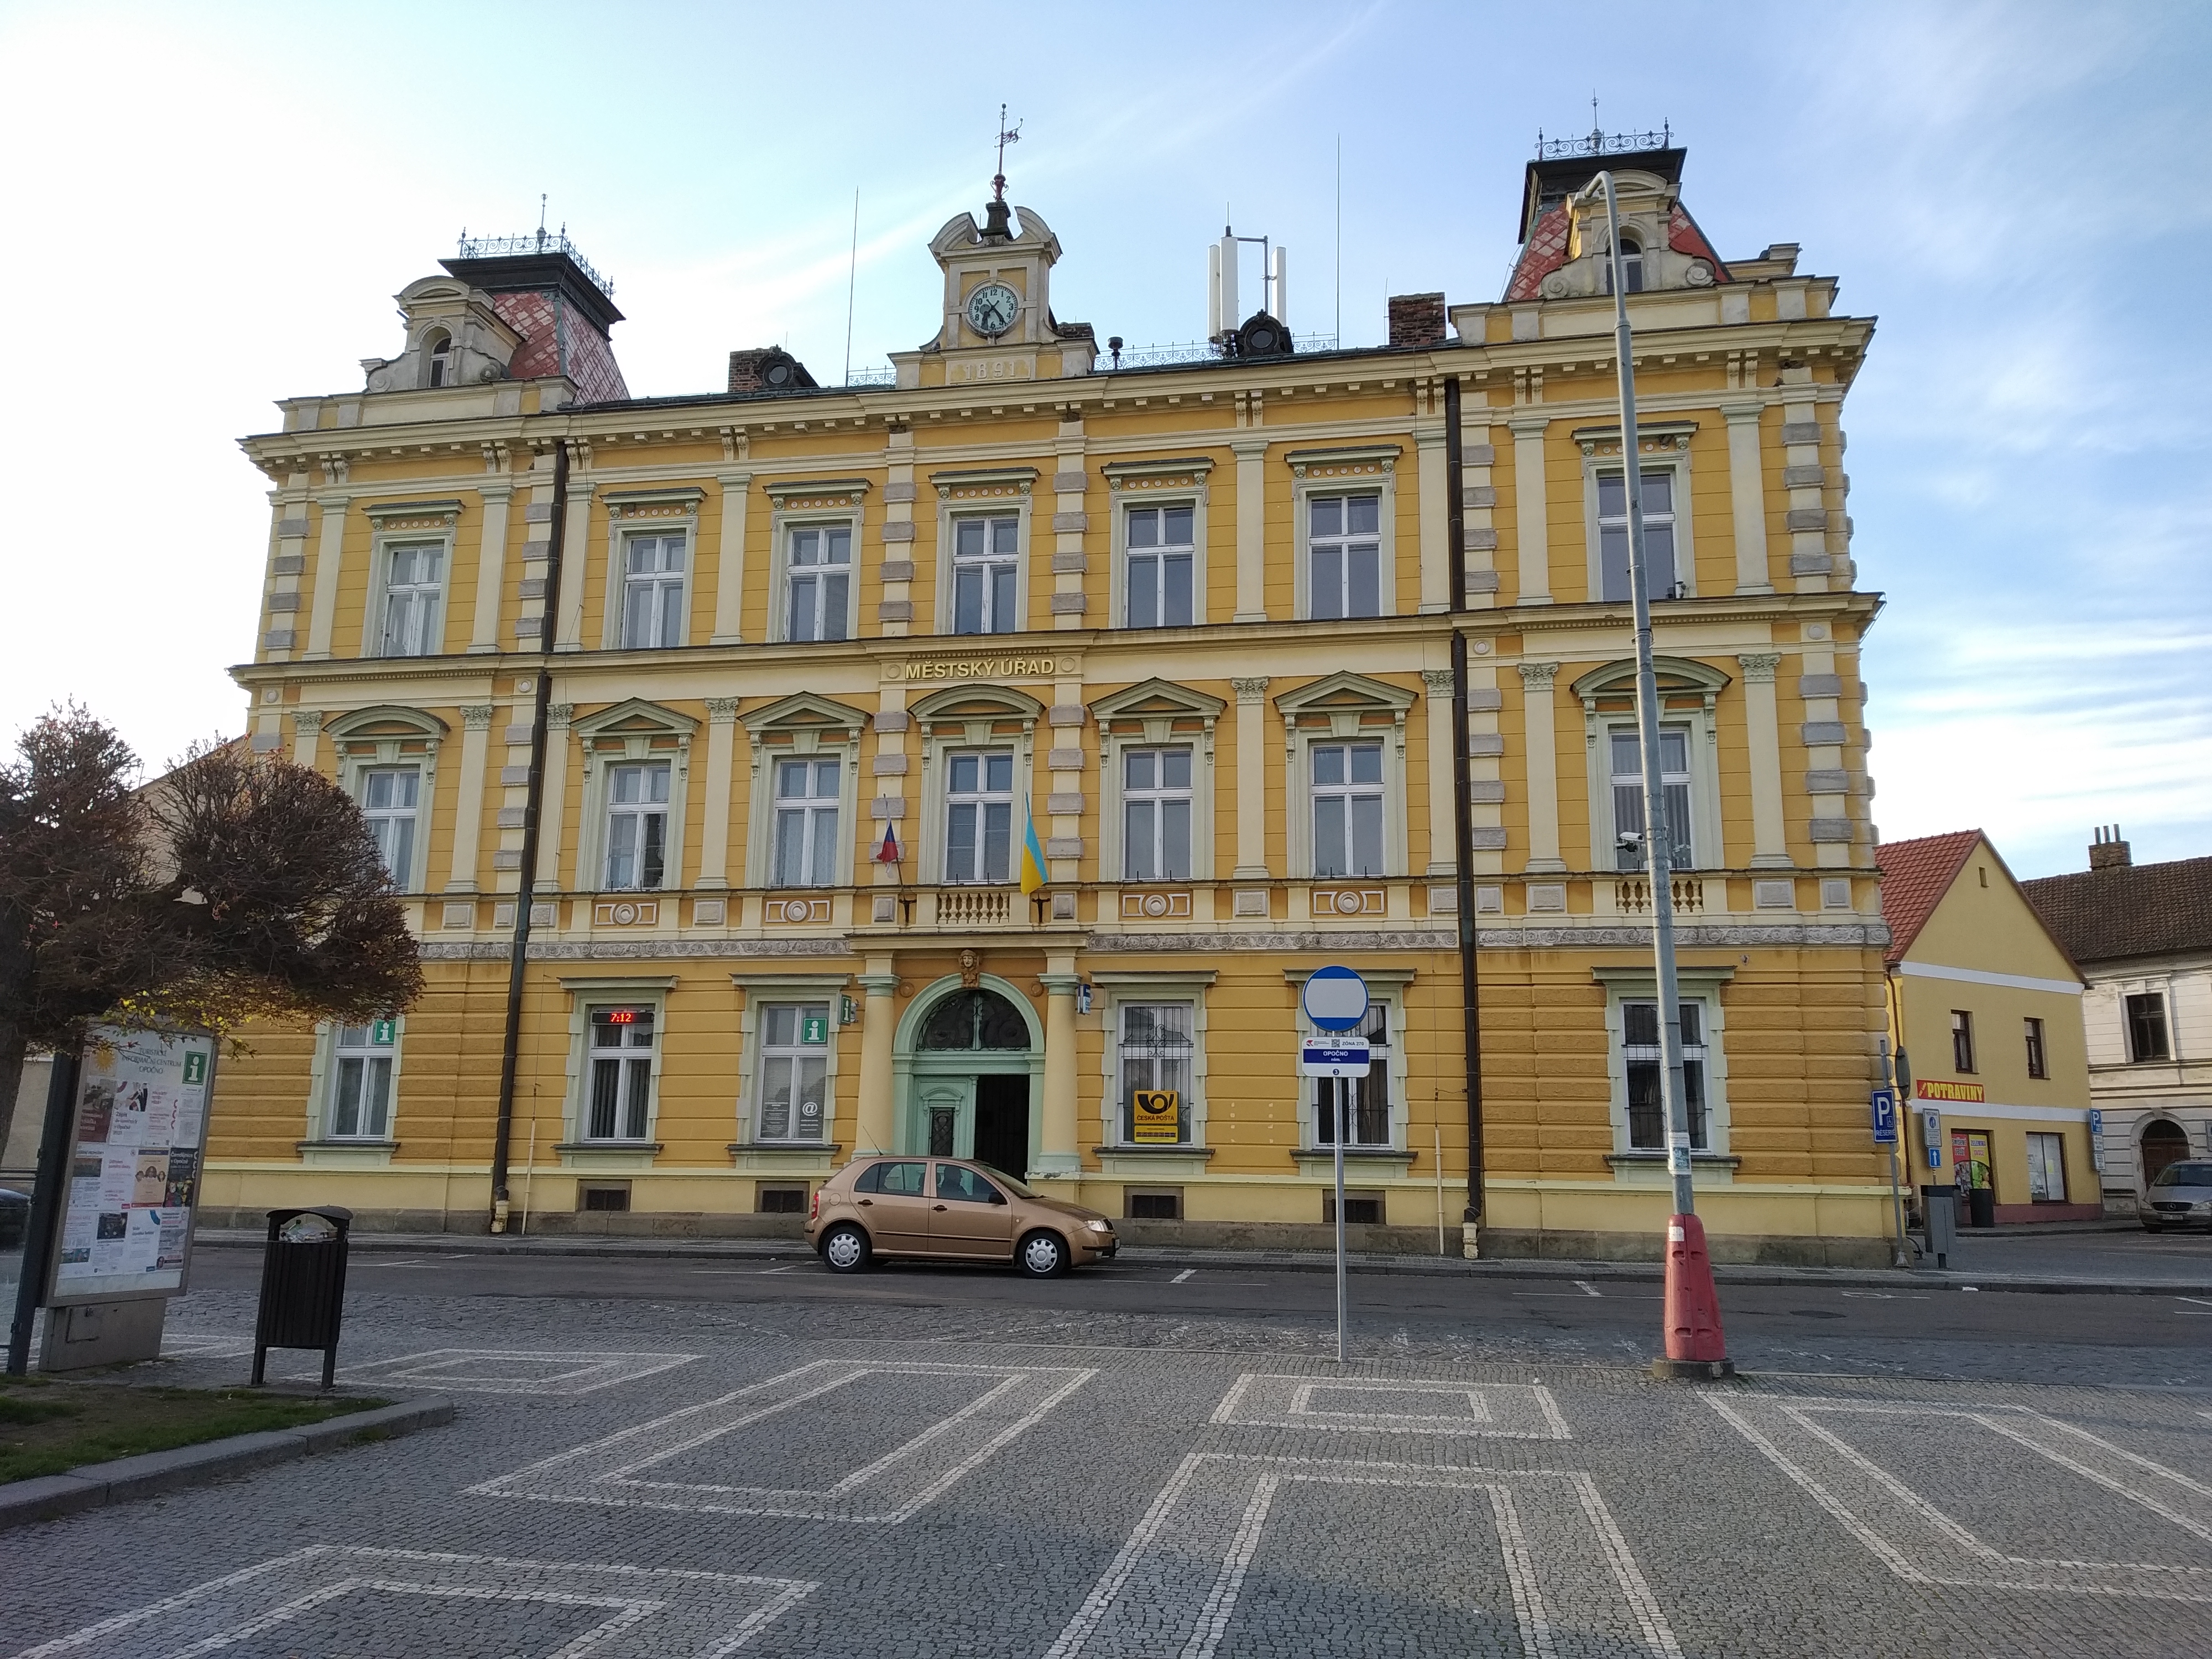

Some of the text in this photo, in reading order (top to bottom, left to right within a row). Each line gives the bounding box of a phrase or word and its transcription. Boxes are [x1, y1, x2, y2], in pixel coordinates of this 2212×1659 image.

[966, 362, 1016, 380] 1891
[906, 657, 1054, 679] MĚSTSKÝ ÚŘAD
[611, 1013, 632, 1022] 7:12
[139, 1066, 163, 1074] OPOČNO
[1927, 1082, 1983, 1101] POTRAVINY
[1877, 1097, 1890, 1125] P
[2093, 1112, 2099, 1125] P
